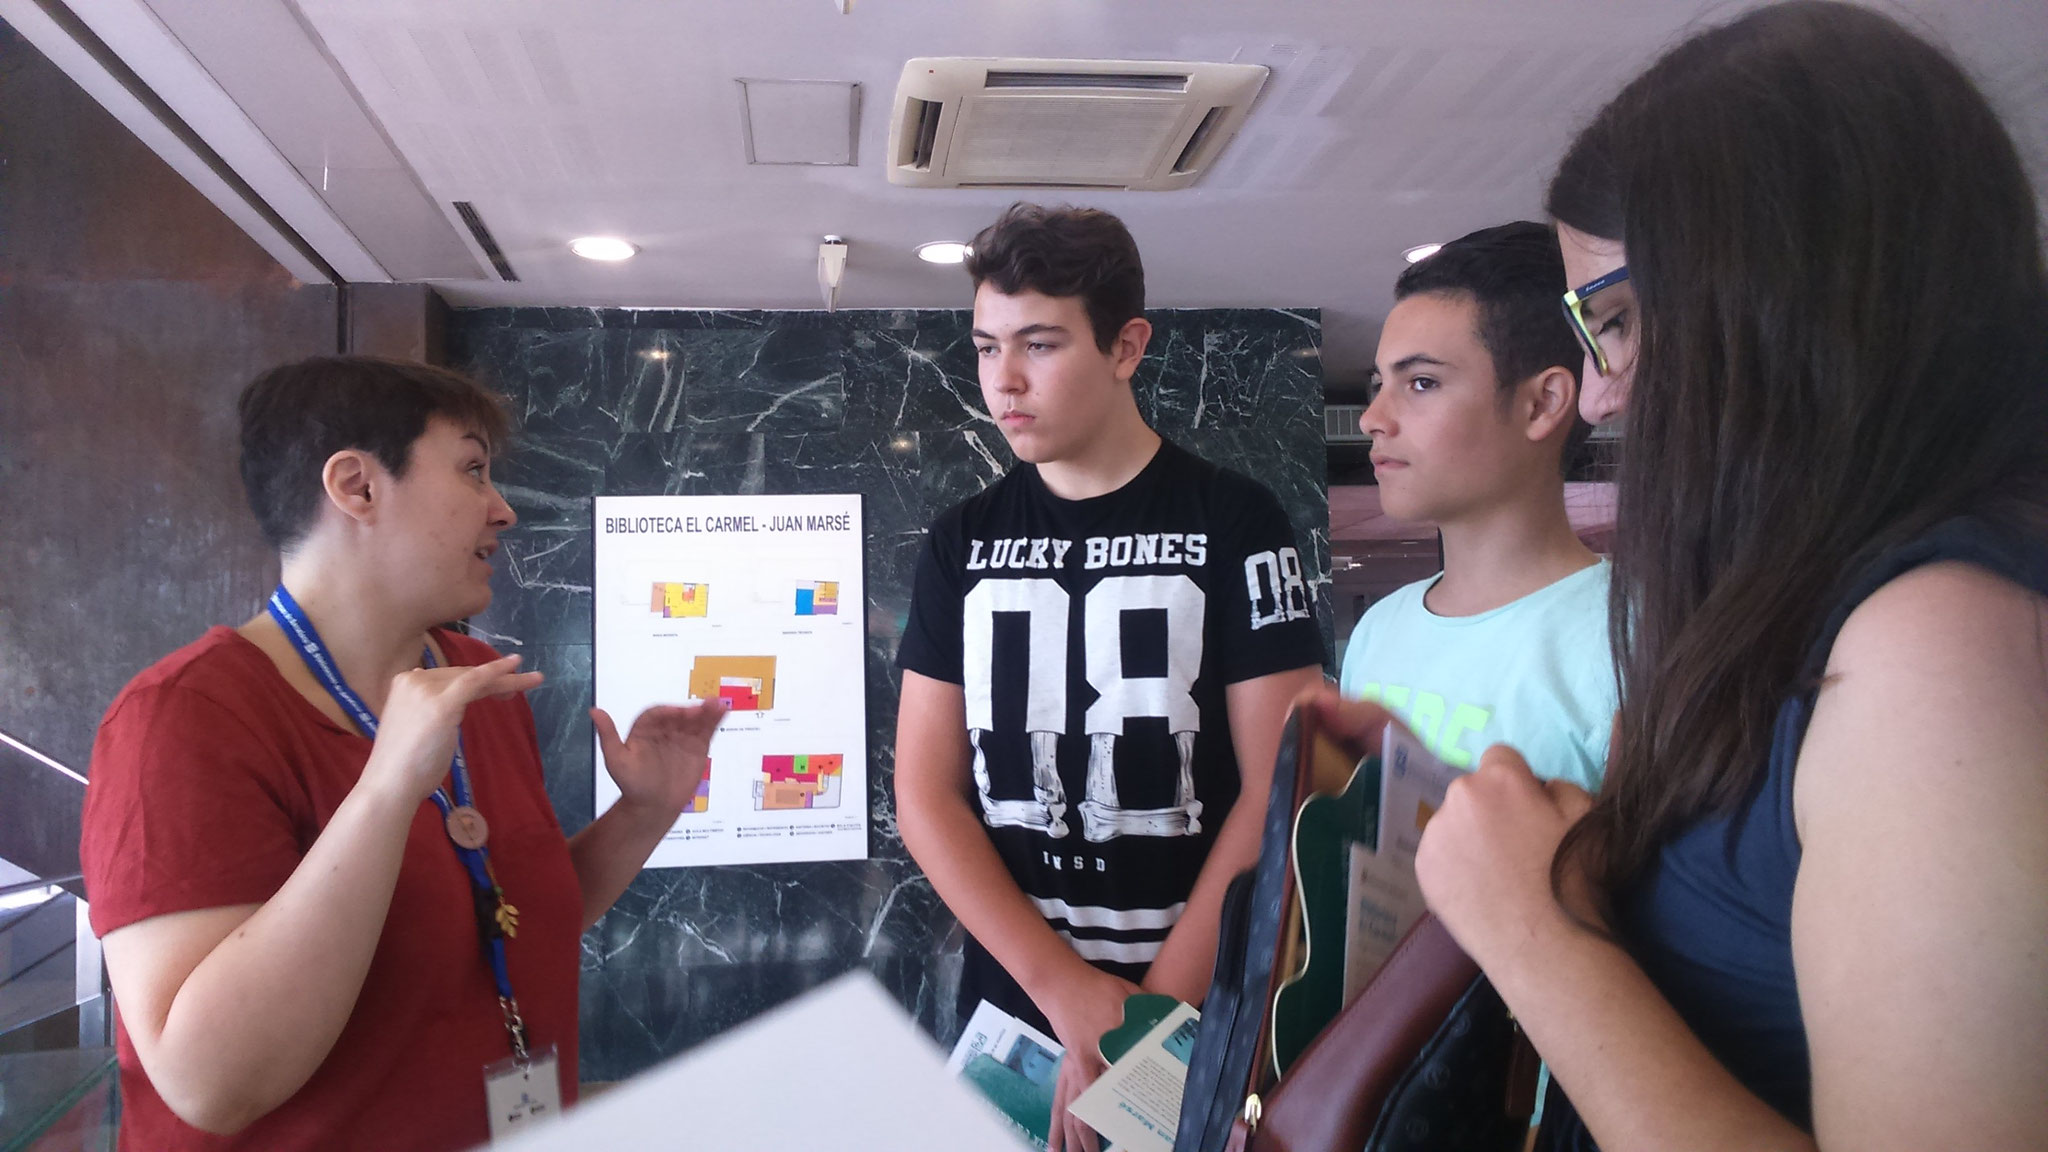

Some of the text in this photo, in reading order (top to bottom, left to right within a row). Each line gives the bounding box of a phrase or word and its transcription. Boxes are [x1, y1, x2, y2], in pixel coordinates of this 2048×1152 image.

[605, 517, 684, 534] BIBLIOTECA
[686, 516, 703, 533] EL
[705, 516, 759, 533] CARMEL
[769, 515, 803, 532] JUAN
[806, 511, 851, 531] MARSÉ
[966, 532, 1208, 571] LUCKY BONES
[1243, 546, 1311, 631] 08
[963, 574, 1206, 844] 08
